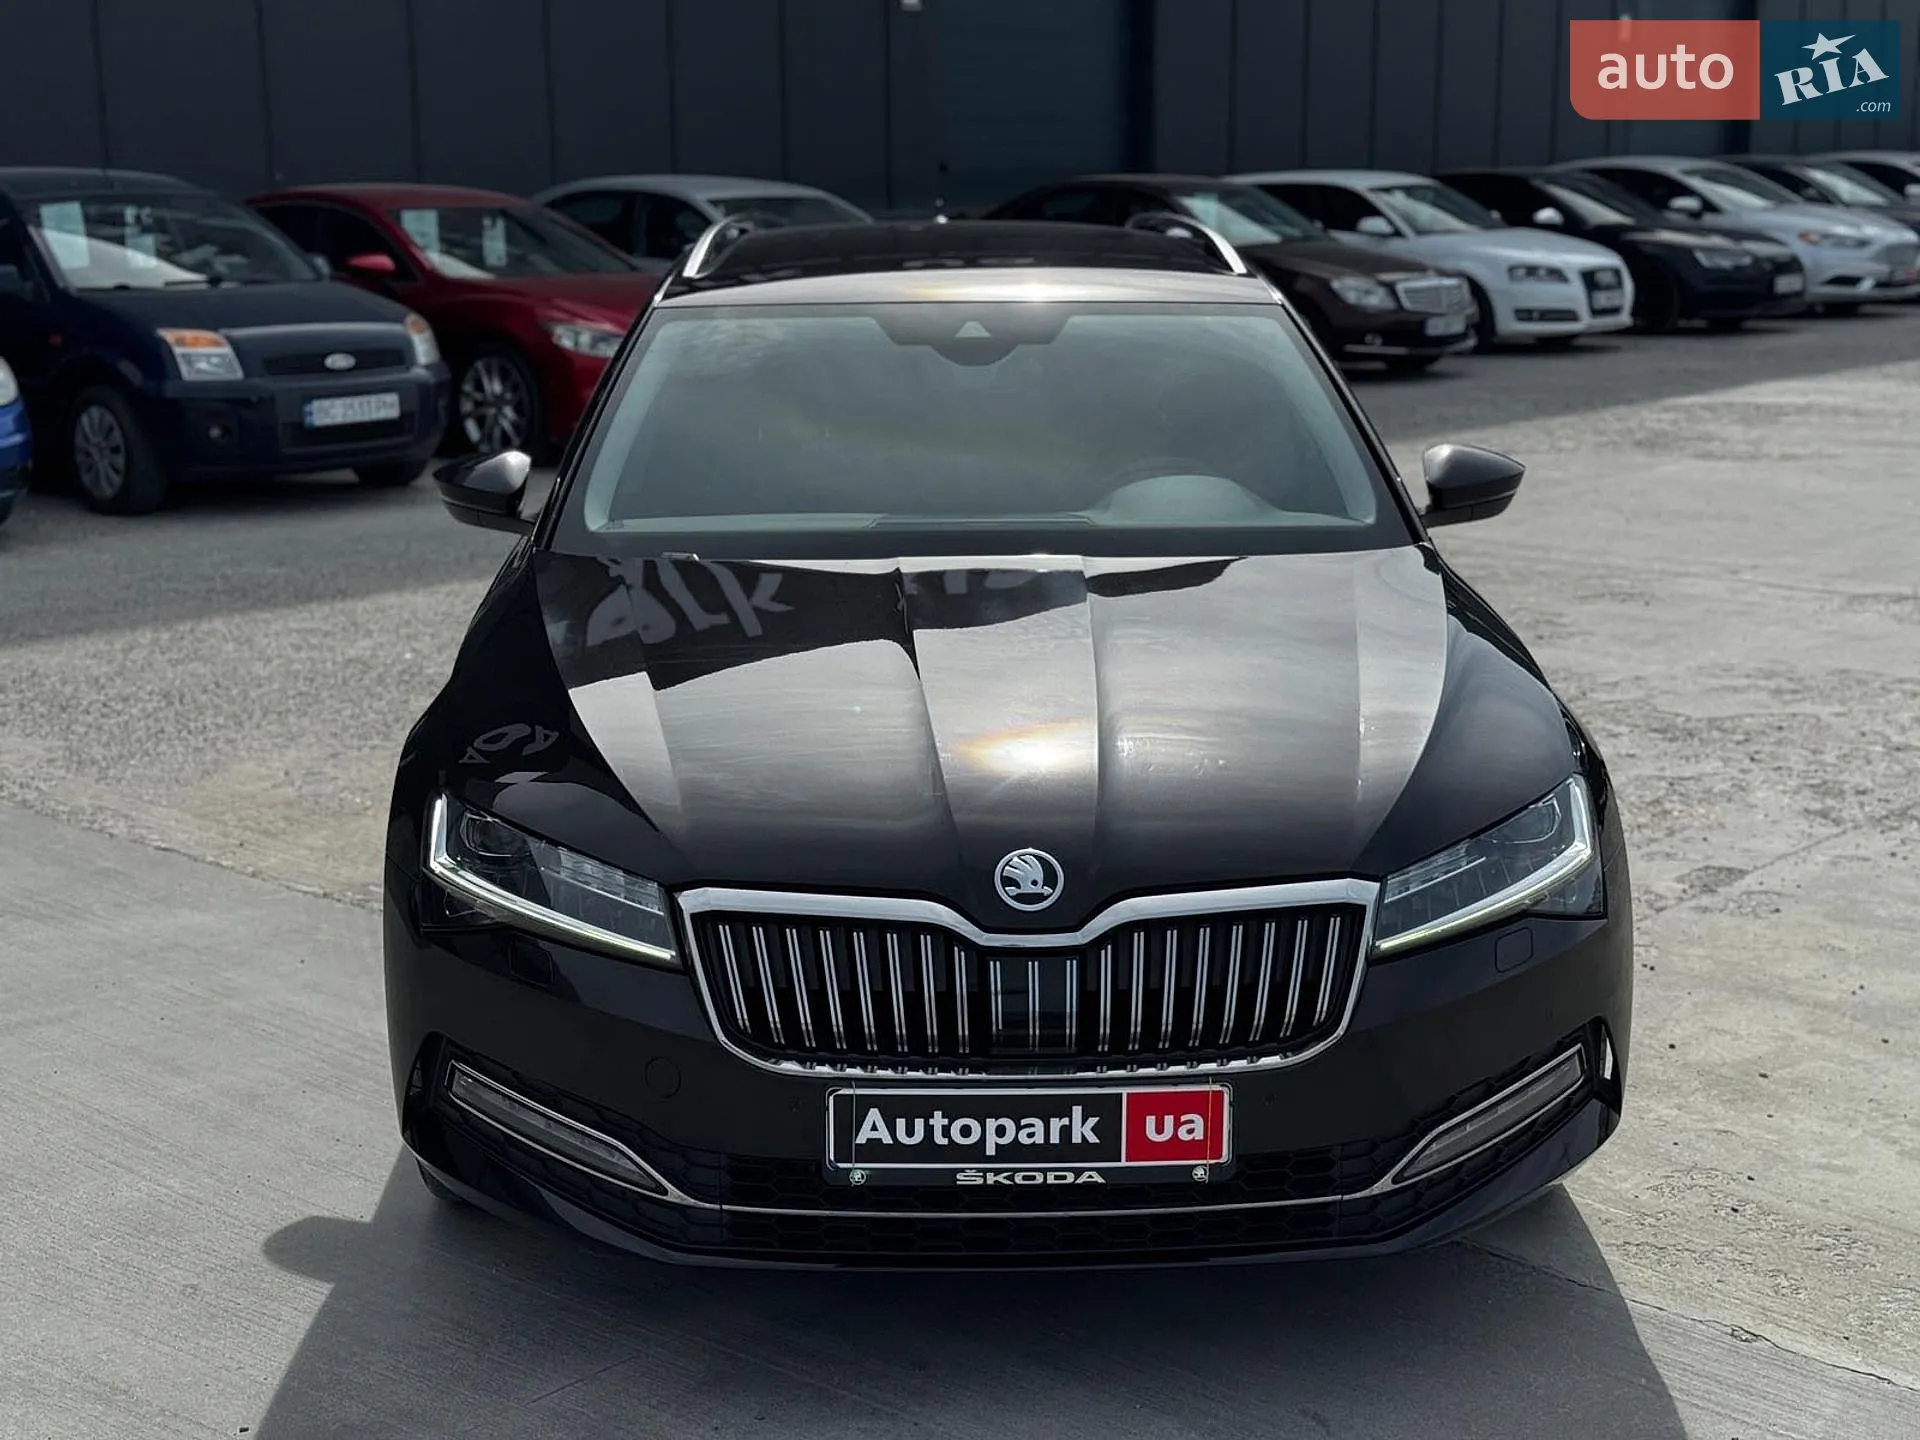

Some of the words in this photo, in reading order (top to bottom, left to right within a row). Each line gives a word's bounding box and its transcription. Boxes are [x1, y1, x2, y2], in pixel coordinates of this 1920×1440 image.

[855, 1105, 1101, 1156] Autopark
[1145, 1112, 1204, 1142] ua
[956, 1169, 1106, 1185] ŠKODA
